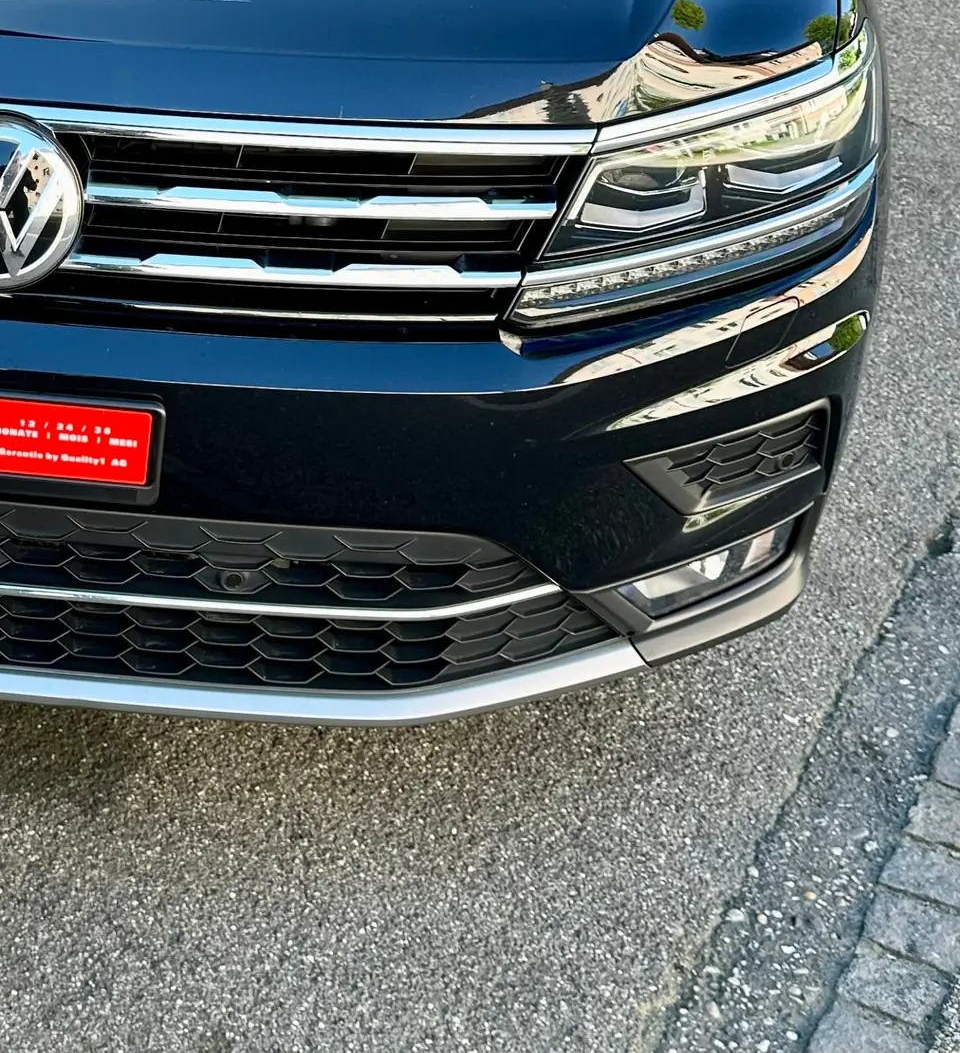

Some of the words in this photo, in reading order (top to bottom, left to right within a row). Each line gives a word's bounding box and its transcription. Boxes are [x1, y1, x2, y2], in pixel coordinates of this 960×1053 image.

[19, 419, 36, 429] 12
[56, 422, 74, 432] 24
[94, 426, 111, 435] 36
[58, 432, 89, 443] MOIS
[108, 437, 138, 448] MESI
[45, 452, 59, 462] by
[60, 453, 105, 466] Quality1
[110, 458, 128, 468] AG
